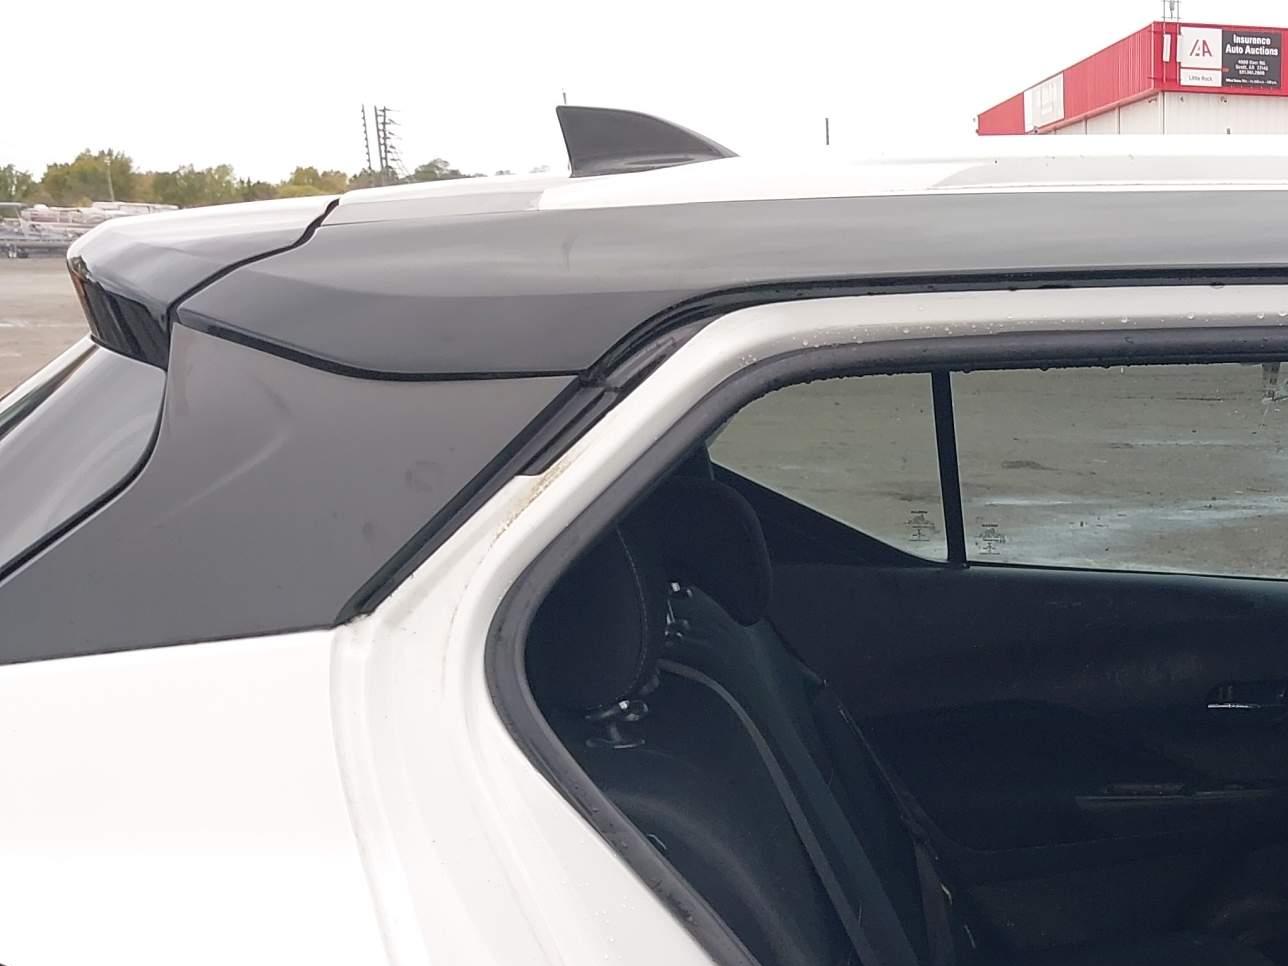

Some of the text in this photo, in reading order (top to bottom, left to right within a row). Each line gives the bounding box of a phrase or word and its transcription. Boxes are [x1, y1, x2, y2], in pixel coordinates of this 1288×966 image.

[1233, 34, 1271, 45] Insurance
[1225, 44, 1279, 56] Auto Auctions
